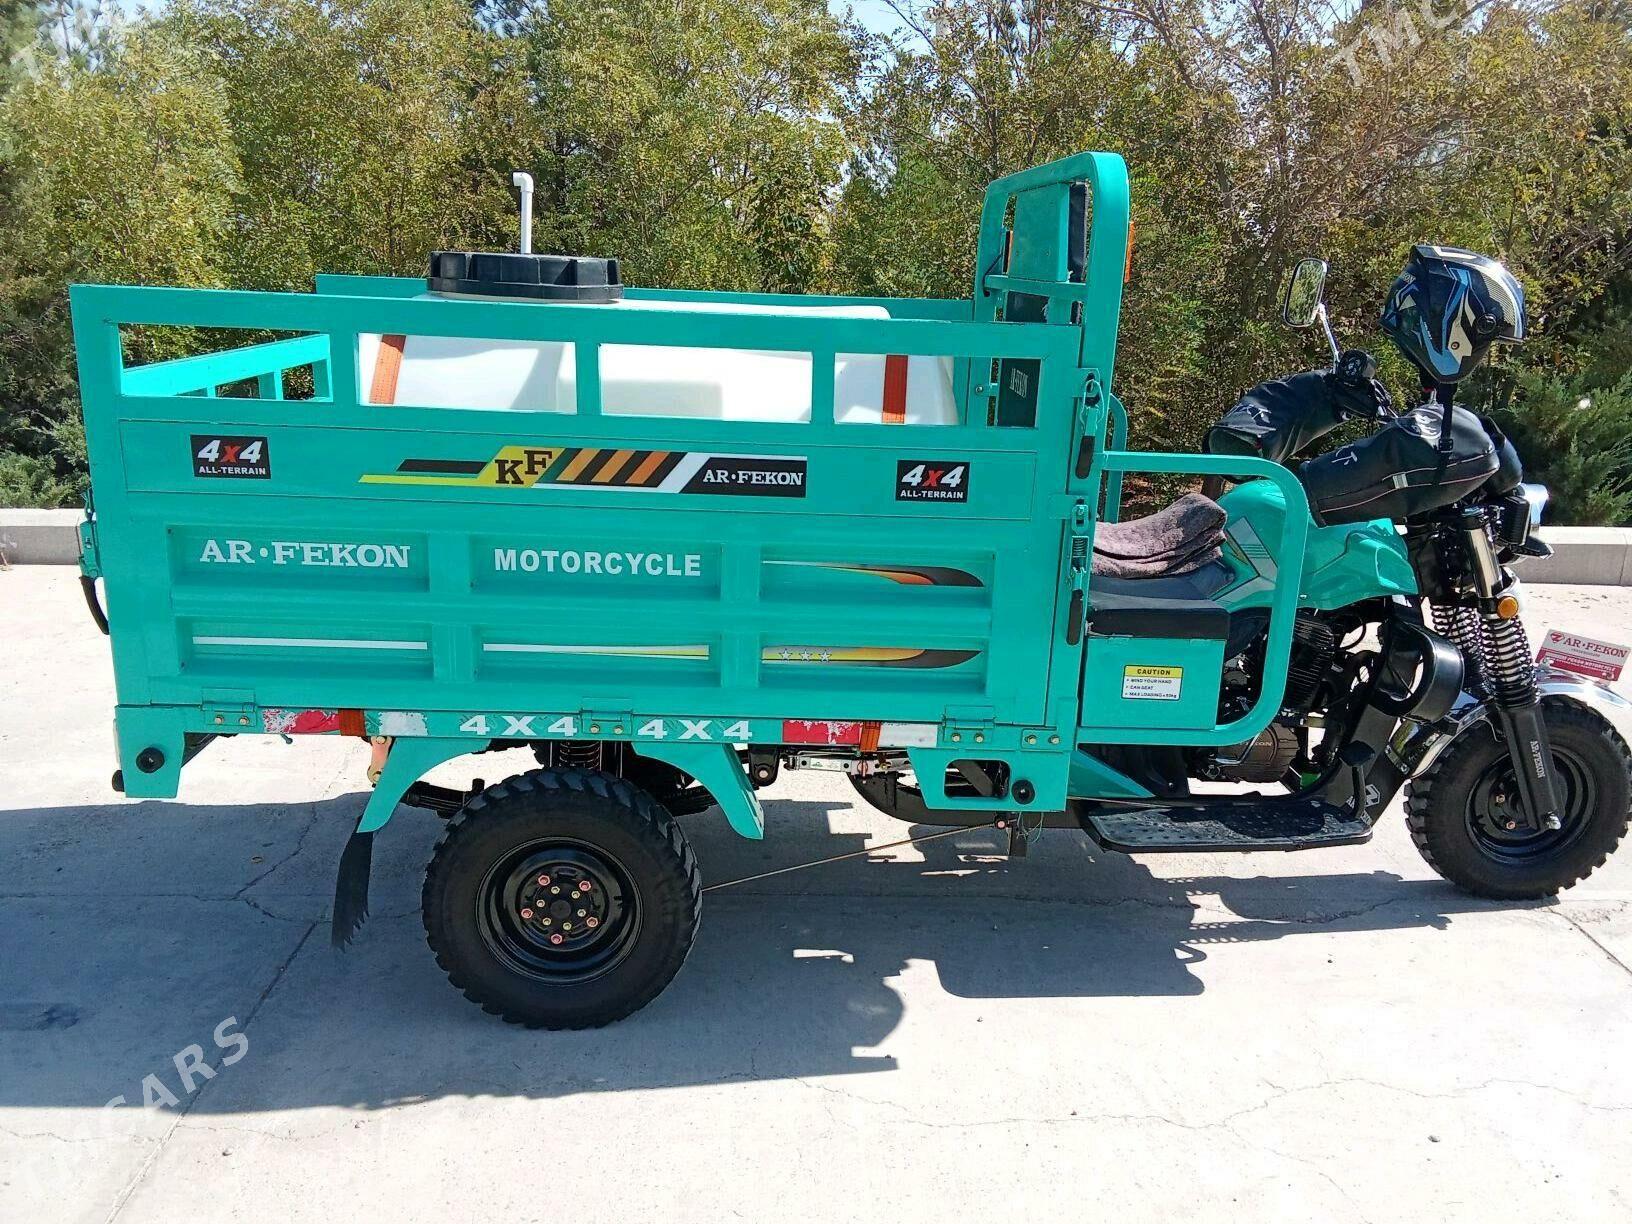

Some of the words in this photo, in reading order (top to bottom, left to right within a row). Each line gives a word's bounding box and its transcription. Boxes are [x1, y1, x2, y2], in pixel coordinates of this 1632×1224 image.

[198, 465, 267, 475] ALL-TERRAIN
[494, 449, 553, 485] KF
[900, 489, 965, 499] ALL-TERRAIN
[493, 547, 701, 577] MOTORCYCLE
